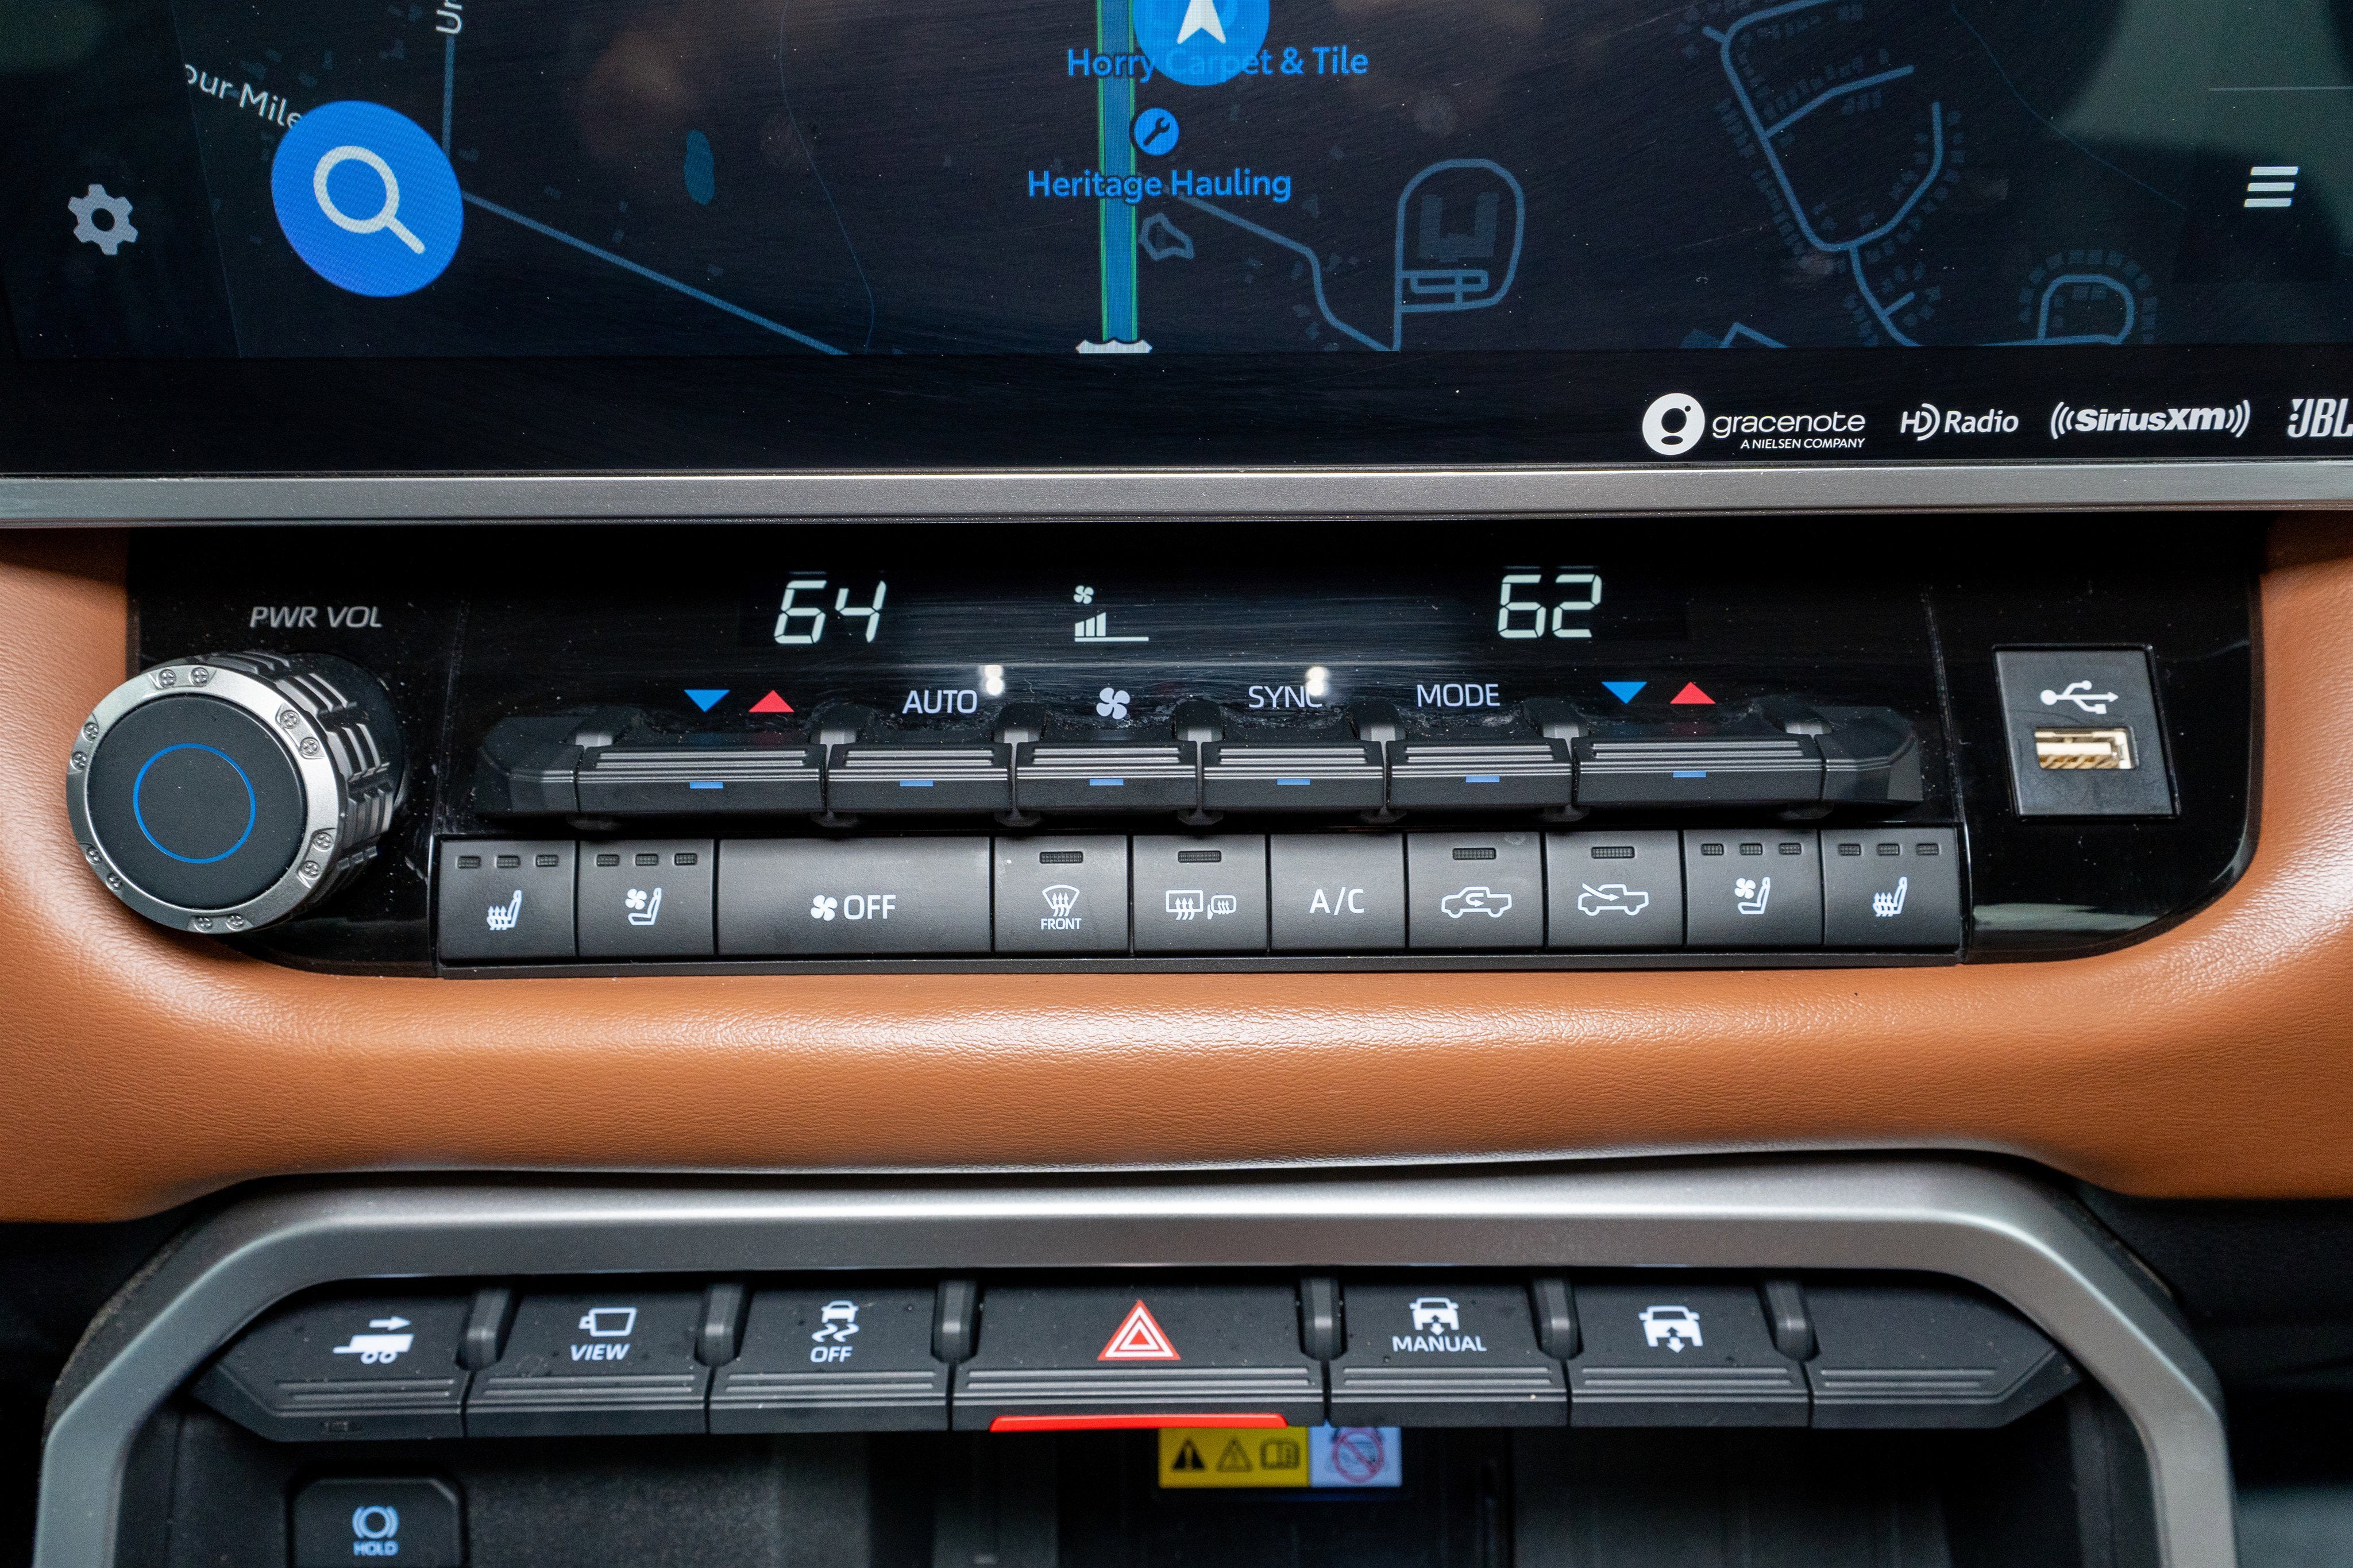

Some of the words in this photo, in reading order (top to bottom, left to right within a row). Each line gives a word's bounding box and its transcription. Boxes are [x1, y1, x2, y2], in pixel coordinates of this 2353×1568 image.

[1068, 48, 1156, 83] Horry
[1166, 48, 1274, 83] Carpet
[1280, 47, 1305, 75] &
[1312, 45, 1369, 75] Tile
[1028, 169, 1163, 203] Heritage
[1171, 168, 1291, 203] Hauling
[1712, 411, 1866, 438] gracenote
[1945, 408, 2019, 434] Radio
[2287, 398, 2353, 438] JBL
[1741, 439, 1750, 449] A
[1753, 439, 1802, 449] NIELSEN
[1803, 438, 1866, 449] COMPANY
[249, 606, 318, 628] PWR
[327, 606, 383, 628] VOL
[773, 580, 886, 644] 64
[1498, 574, 1602, 639] 62
[902, 690, 977, 714] AUTO
[1417, 683, 1500, 708] MODE
[843, 894, 897, 920] OFF
[1309, 886, 1364, 916] A/C
[1040, 917, 1082, 930] FRONT
[570, 1343, 630, 1361] VIEW
[810, 1346, 853, 1363] OFF
[1392, 1335, 1487, 1352] MANUAL
[353, 1540, 399, 1556] HOLD
